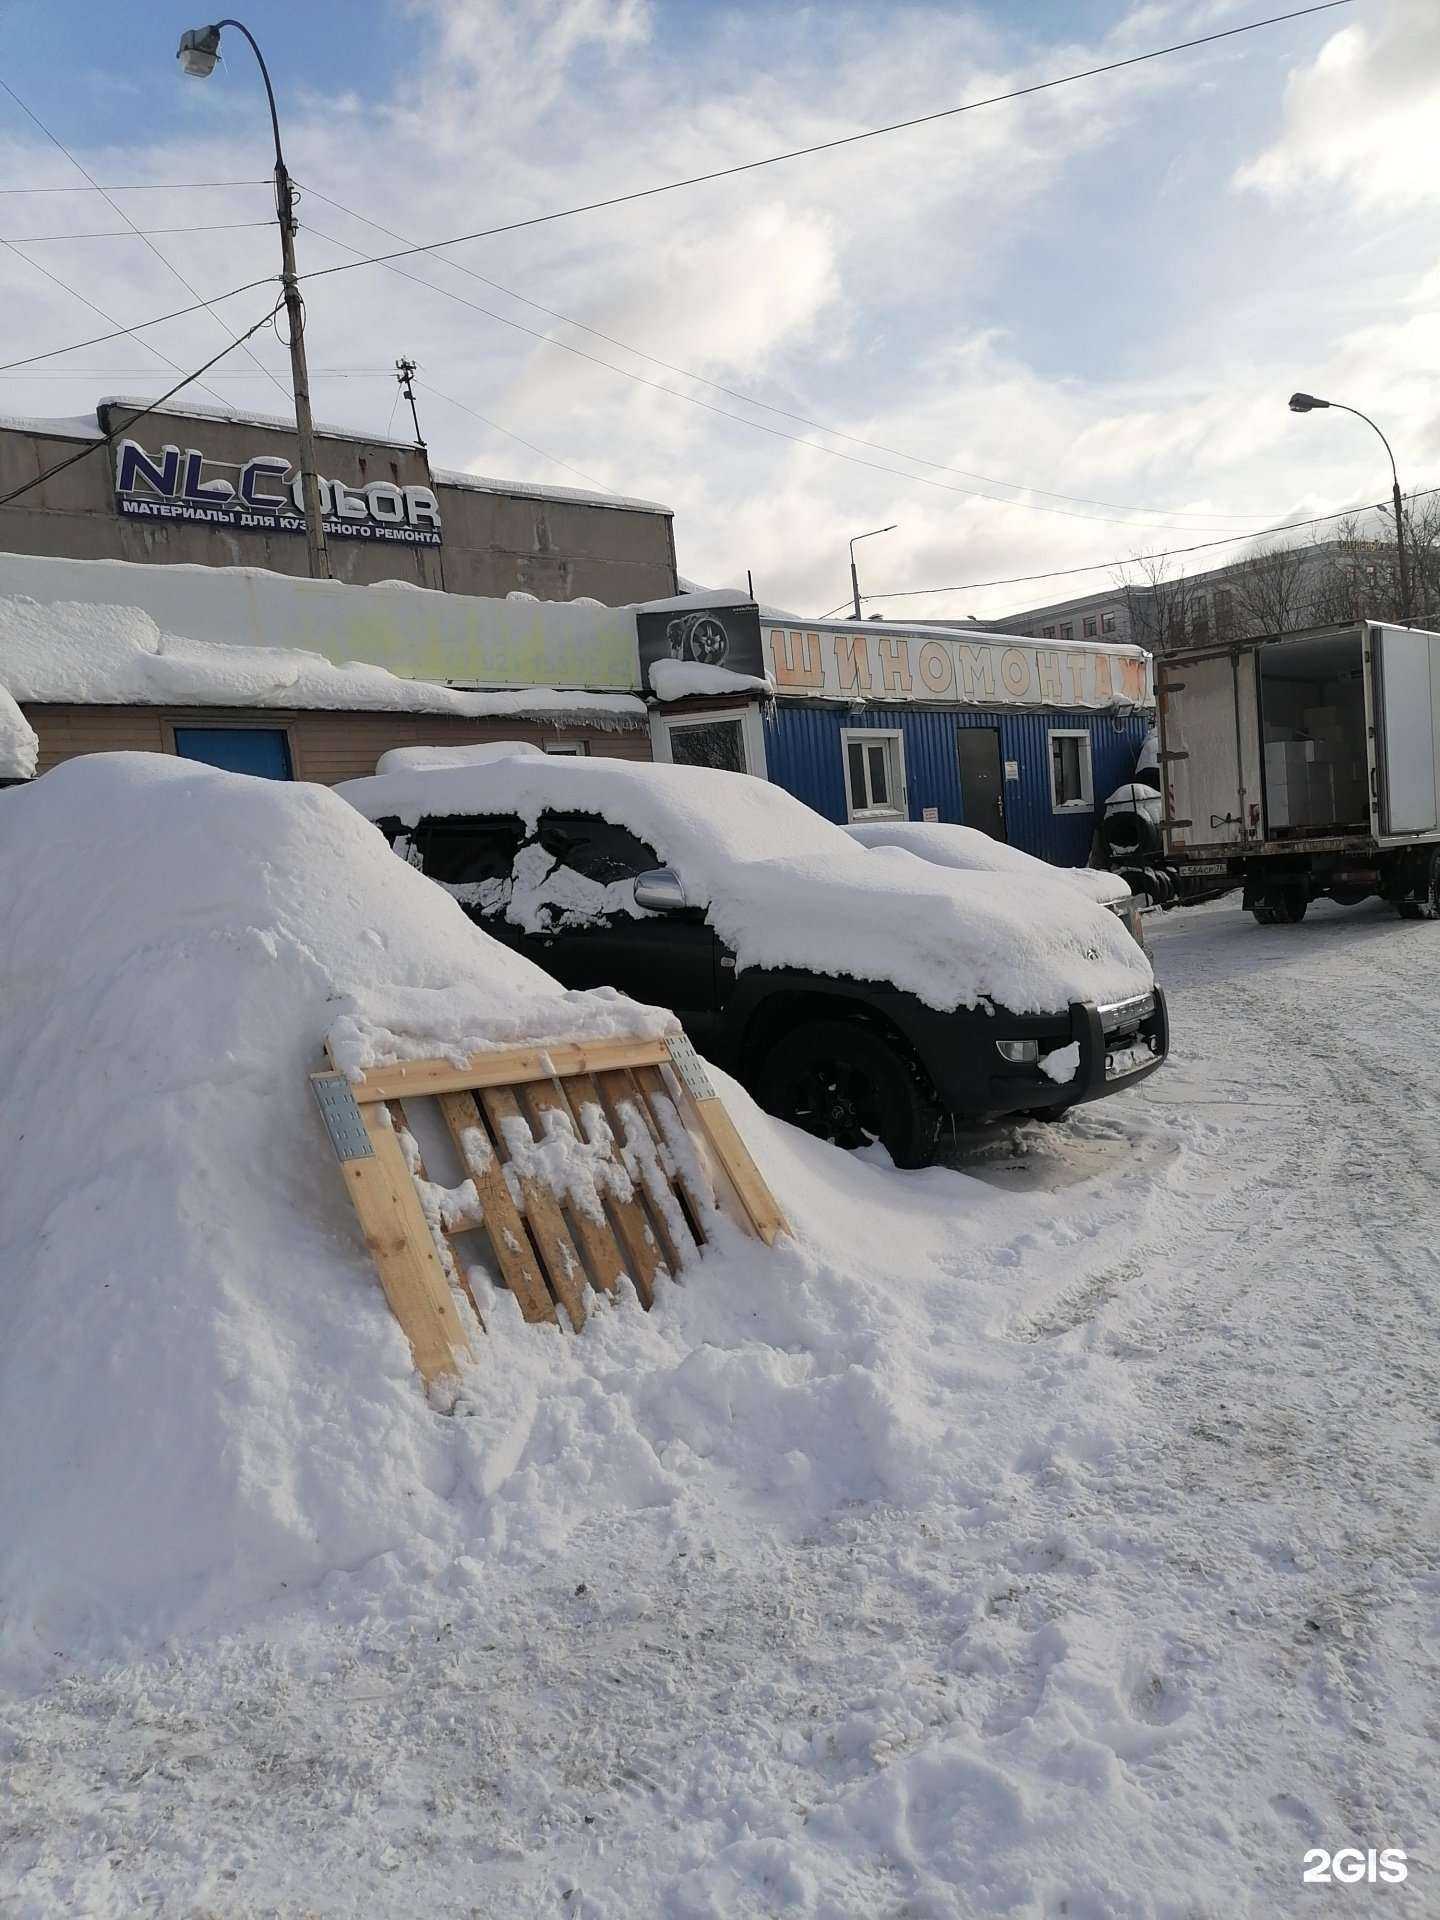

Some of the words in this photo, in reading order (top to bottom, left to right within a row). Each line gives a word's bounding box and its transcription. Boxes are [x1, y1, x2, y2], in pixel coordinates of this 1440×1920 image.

[122, 501, 235, 523] МАТЕРИАЛЫ
[240, 513, 275, 528] ДЛЯ
[280, 516, 371, 538] КУЗВНОГО
[375, 527, 441, 544] РЕМОНТА
